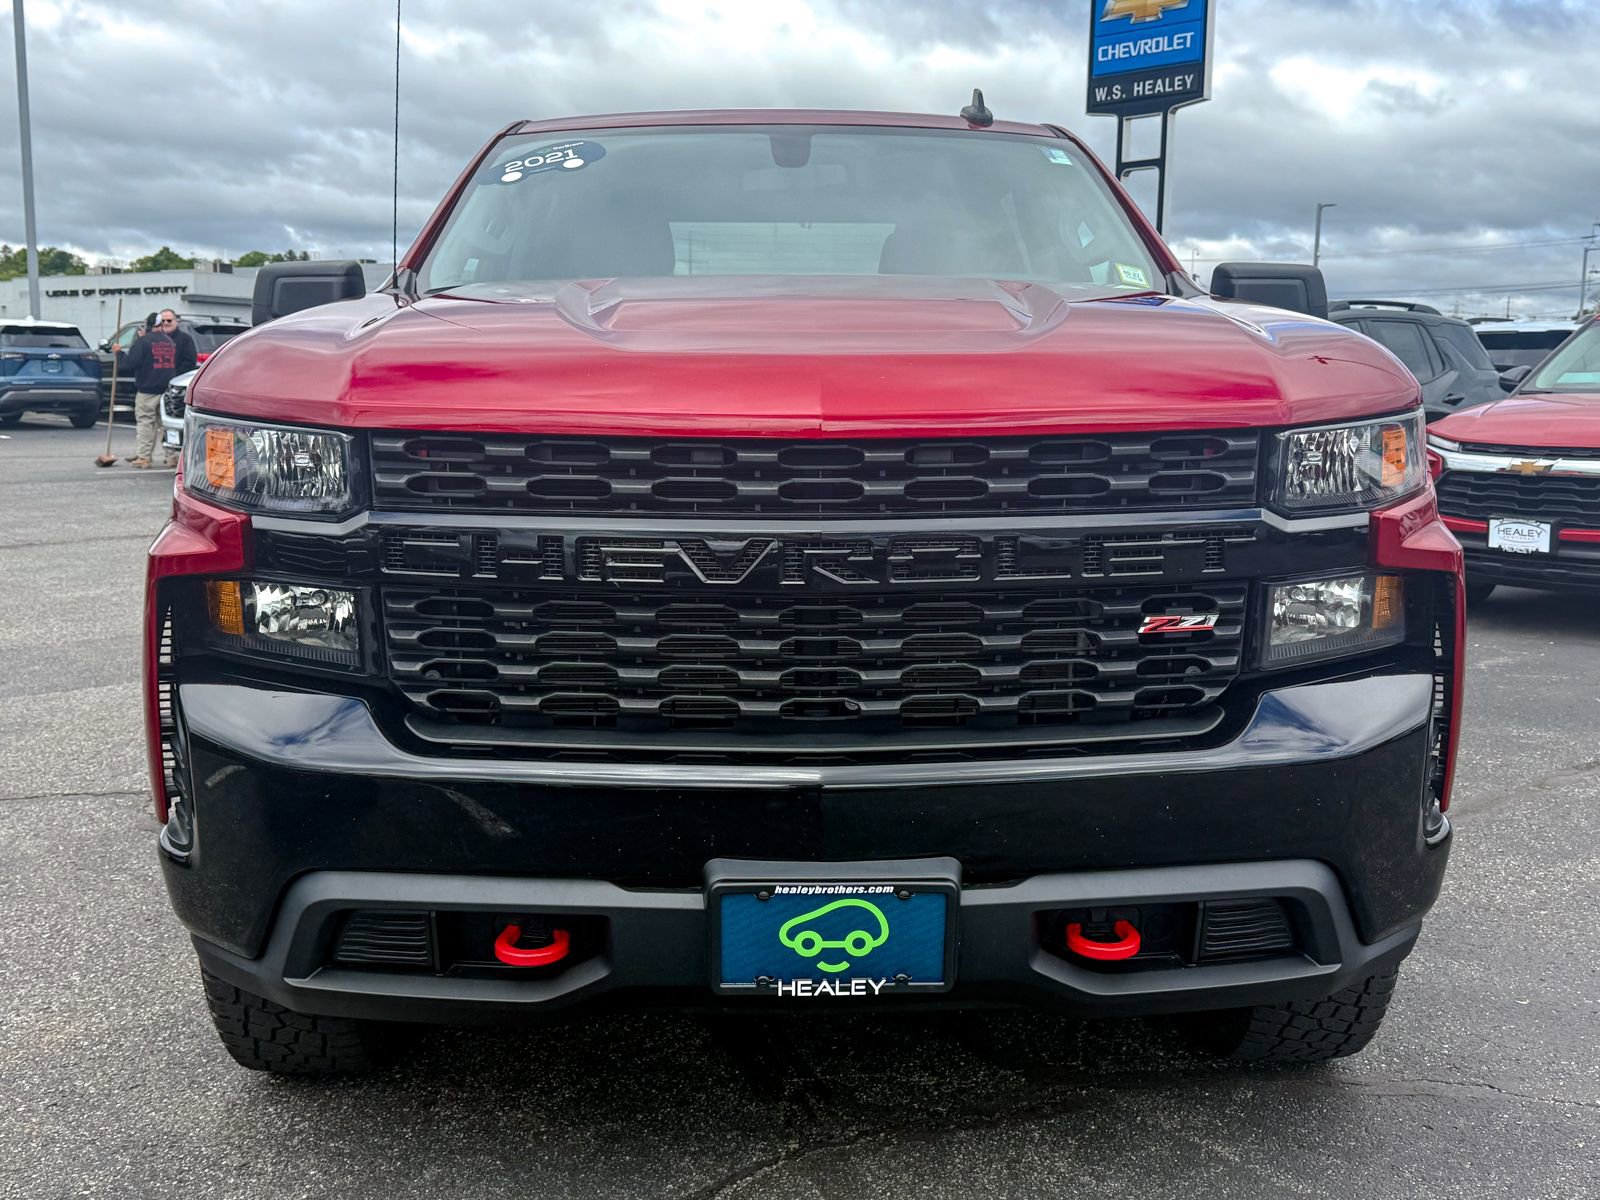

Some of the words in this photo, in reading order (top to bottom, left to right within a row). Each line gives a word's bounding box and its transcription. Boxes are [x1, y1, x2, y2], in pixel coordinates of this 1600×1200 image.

[1098, 32, 1195, 62] CHEVROLET
[1095, 85, 1126, 102] W.S.
[1133, 74, 1194, 97] HEALEY
[504, 148, 578, 173] 2021
[82, 289, 96, 297] OF
[99, 287, 141, 296] ORANGE
[143, 286, 188, 295] COUNTY
[1497, 527, 1543, 538] HEALEY
[379, 530, 1257, 585] CHEVROLET
[1137, 614, 1219, 634] Z71
[774, 884, 895, 896] healeybrothers.com
[777, 978, 887, 997] HEALEY
